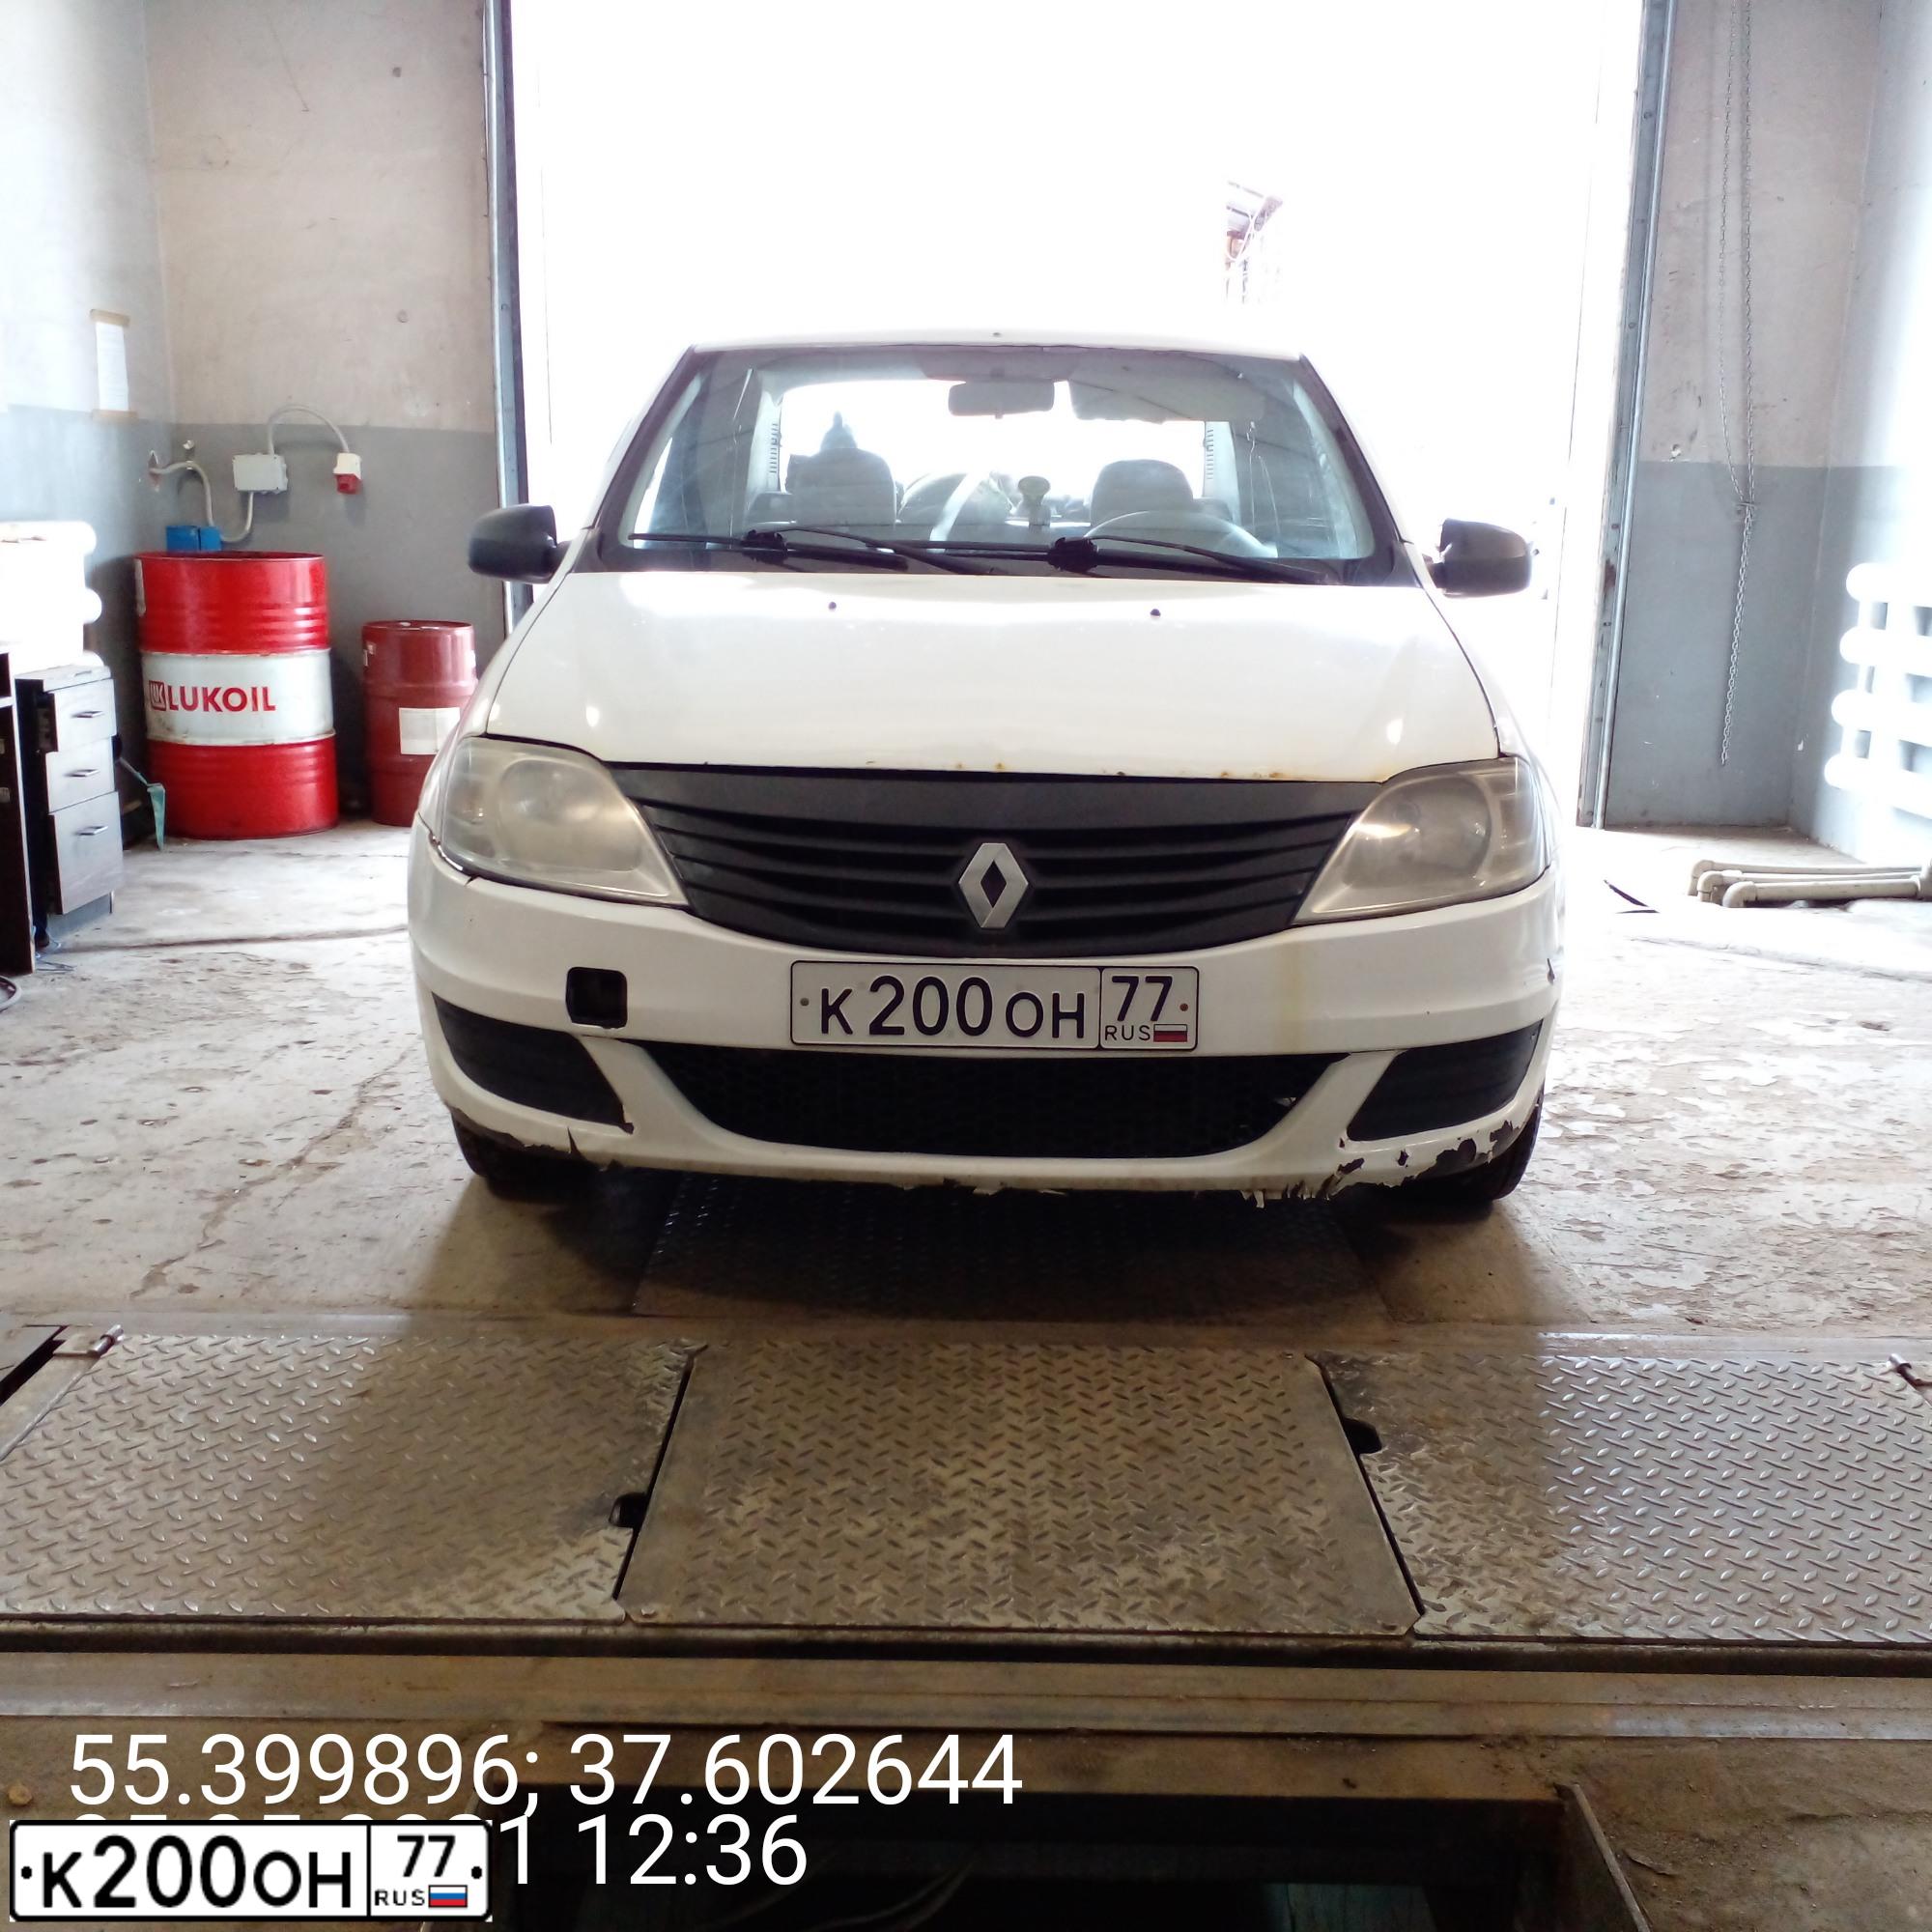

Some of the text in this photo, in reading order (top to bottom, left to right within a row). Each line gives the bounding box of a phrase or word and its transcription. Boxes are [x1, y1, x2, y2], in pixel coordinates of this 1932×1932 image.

[167, 685, 276, 712] LUKOIL
[1111, 975, 1174, 1022] 77
[1104, 1025, 1151, 1041] RUS
